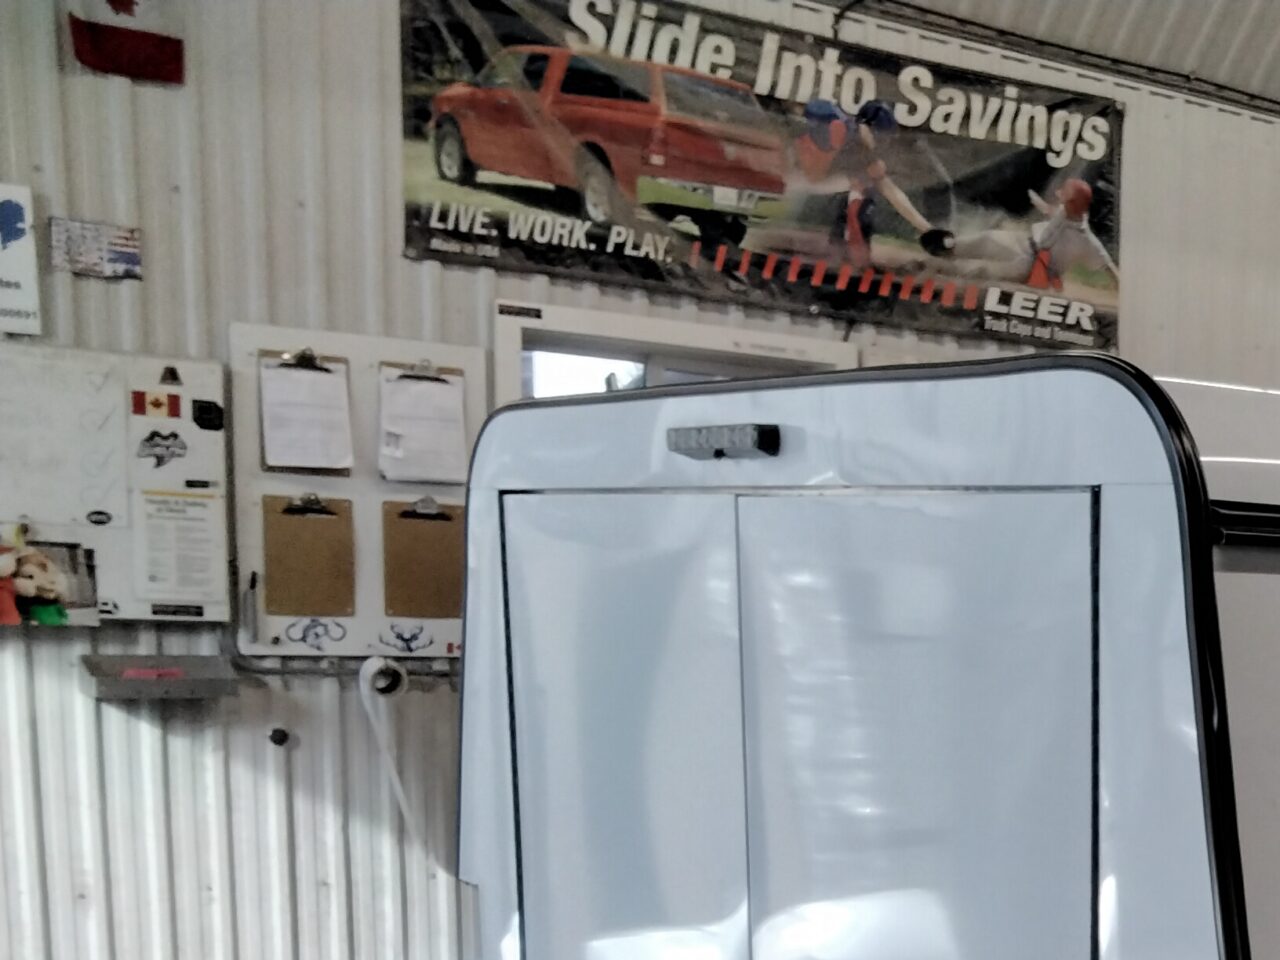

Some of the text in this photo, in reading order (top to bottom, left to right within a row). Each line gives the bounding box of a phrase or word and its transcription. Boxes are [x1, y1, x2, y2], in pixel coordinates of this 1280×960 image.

[565, 0, 1110, 168] Slide Into Savings
[429, 201, 673, 263] LIVE. WORK. PLAY.
[984, 287, 1095, 331] LEER
